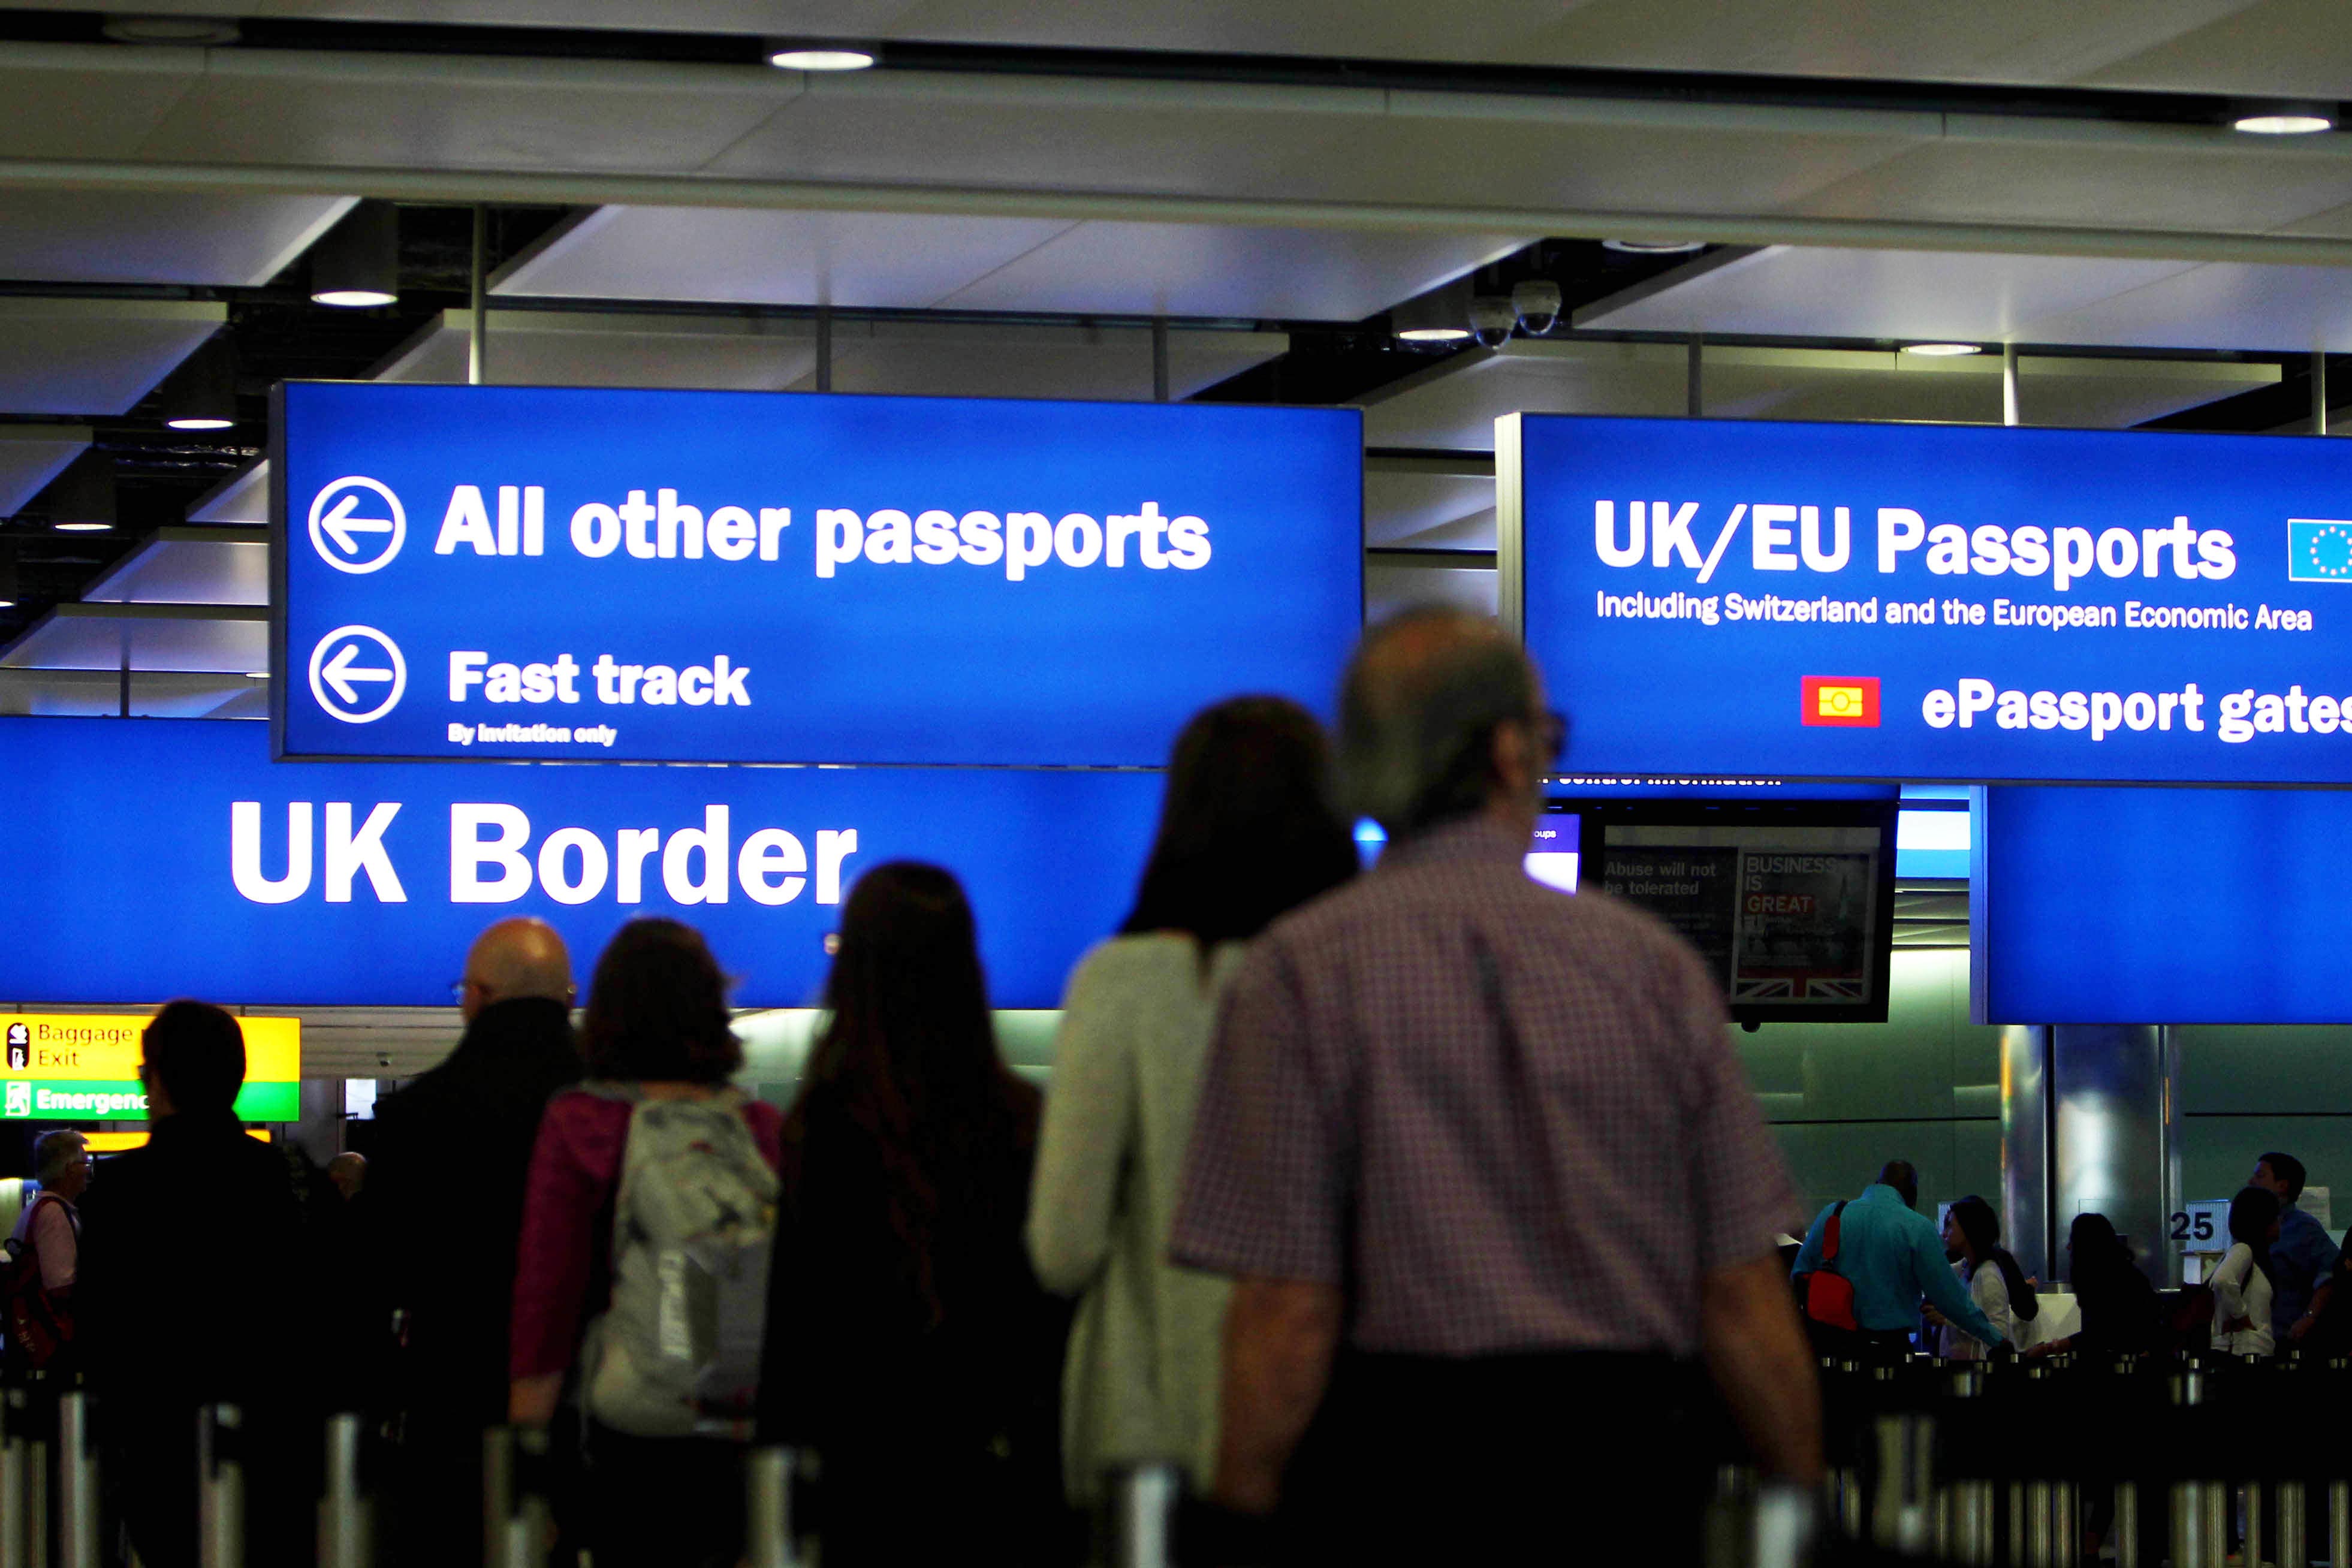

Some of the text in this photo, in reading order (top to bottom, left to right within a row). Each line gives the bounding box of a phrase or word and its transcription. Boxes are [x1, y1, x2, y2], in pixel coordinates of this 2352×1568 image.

[433, 484, 1213, 582] All other passports
[1594, 499, 2238, 592] UK/EU Passports
[1596, 589, 2313, 632] Including Switzerland and the European Economic Area
[448, 650, 752, 707] Fast track
[1921, 677, 2205, 742] ePassport
[447, 722, 618, 748] By invitation only
[230, 800, 858, 907] UK Border
[1747, 856, 1837, 873] BUSINESS
[1605, 862, 1716, 877] Abuse will not
[1629, 881, 1700, 895] tolerated
[1745, 875, 1763, 891] IS
[1747, 895, 1812, 912] GREAT
[39, 1024, 133, 1045] Baggage
[39, 1049, 79, 1066] Exit
[37, 1088, 150, 1115] Emergenc
[2170, 1211, 2214, 1241] 25
